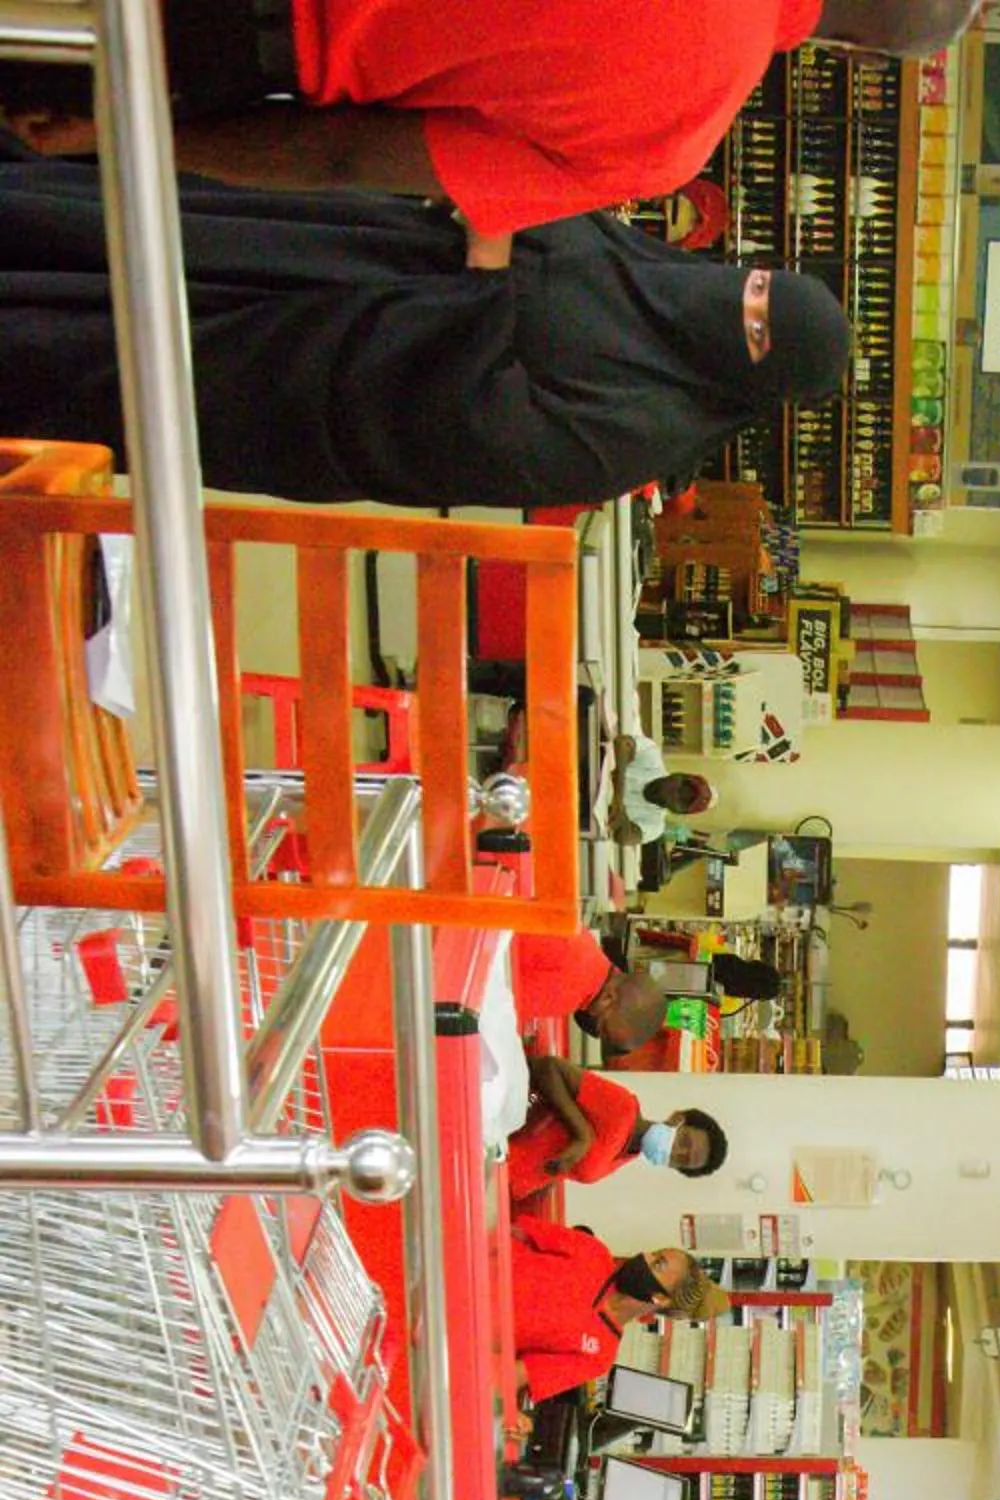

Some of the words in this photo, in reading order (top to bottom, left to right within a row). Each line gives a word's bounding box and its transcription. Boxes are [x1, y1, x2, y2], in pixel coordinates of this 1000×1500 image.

[812, 619, 827, 652] BIG,
[800, 619, 812, 693] FLAVOU
[811, 657, 825, 692] BOL
